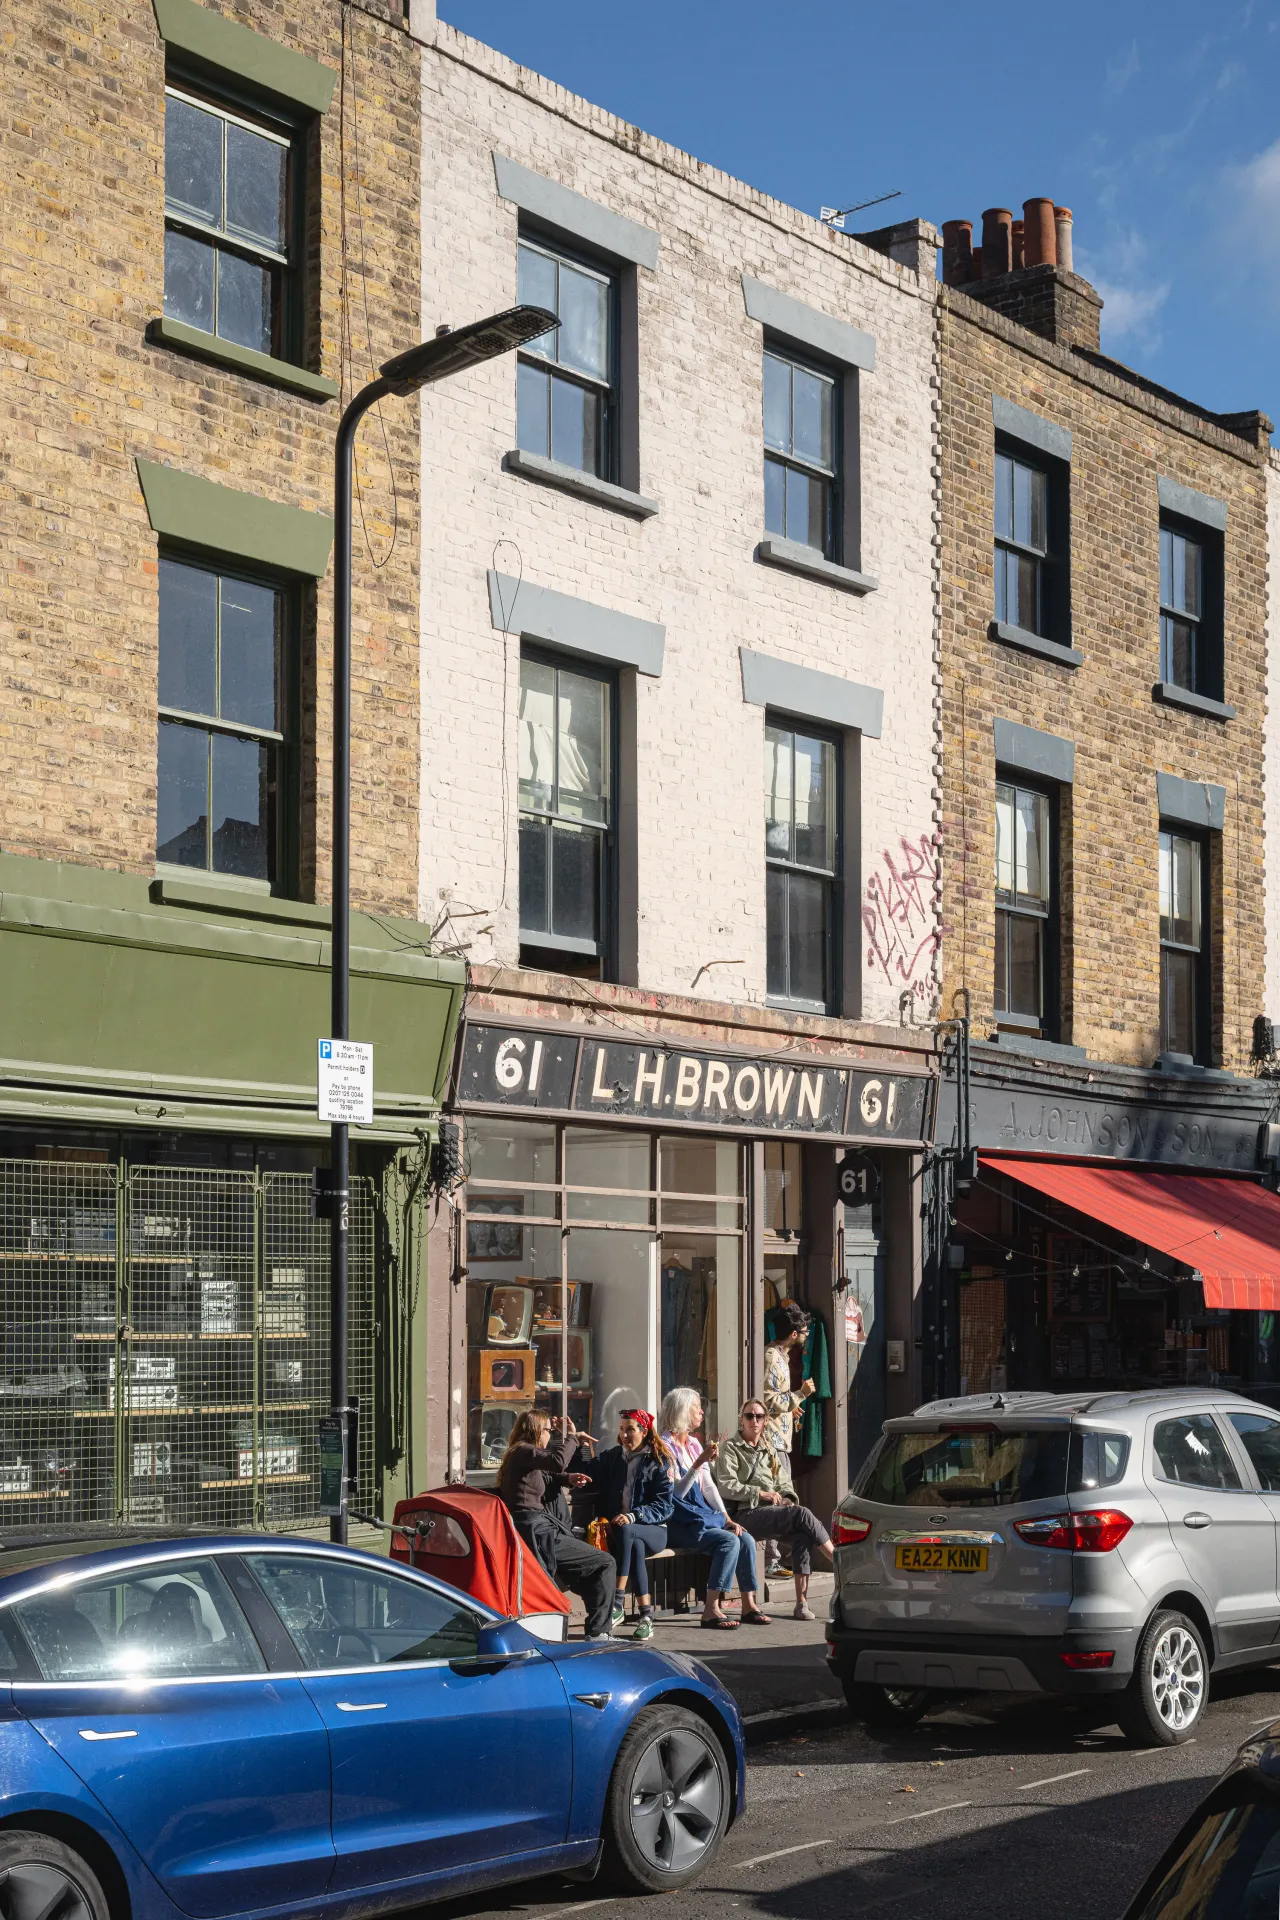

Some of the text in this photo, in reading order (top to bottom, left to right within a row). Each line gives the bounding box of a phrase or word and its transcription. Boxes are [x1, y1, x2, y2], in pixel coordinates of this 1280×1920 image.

[322, 1042, 330, 1057] P
[494, 1037, 543, 1091] 61
[592, 1048, 615, 1098] L
[860, 1079, 896, 1125] 61
[1171, 1122, 1217, 1157] SON
[841, 1168, 868, 1194] 61
[902, 1548, 981, 1568] EA22 KNN
